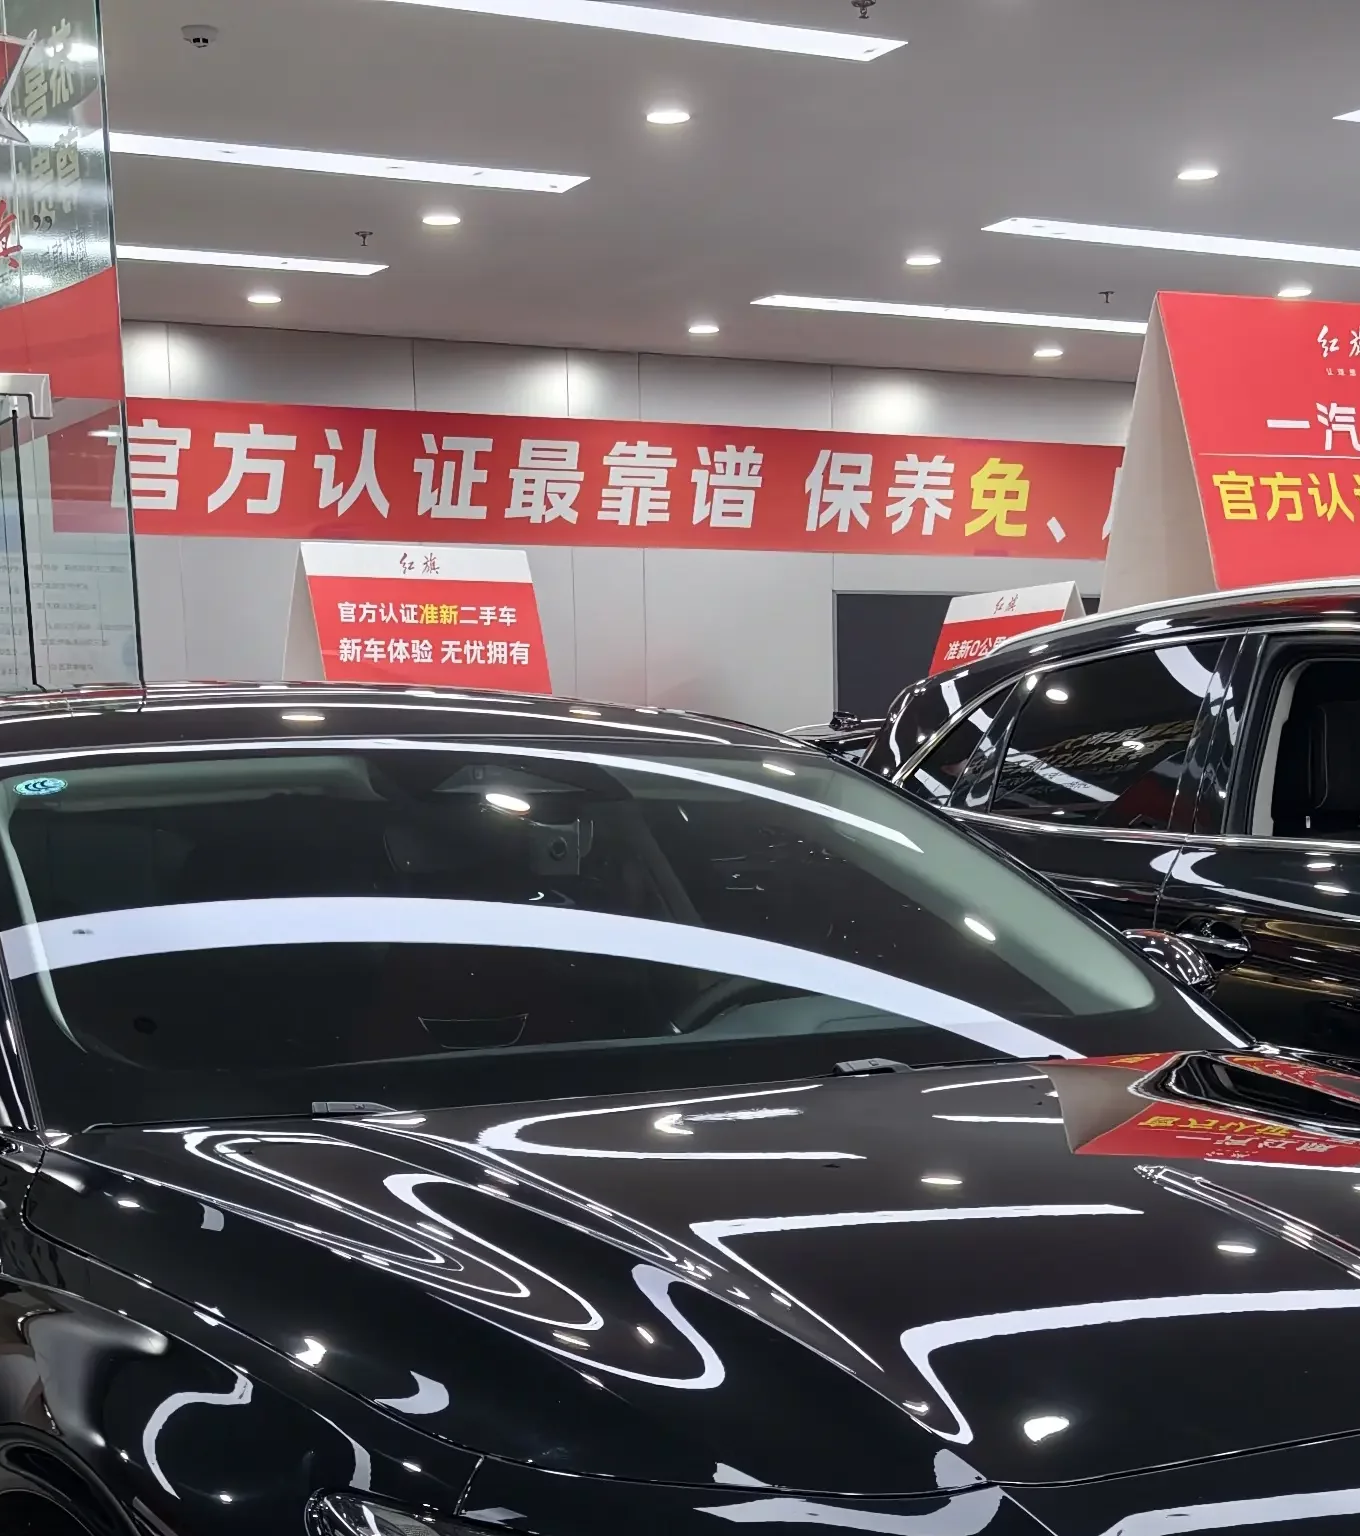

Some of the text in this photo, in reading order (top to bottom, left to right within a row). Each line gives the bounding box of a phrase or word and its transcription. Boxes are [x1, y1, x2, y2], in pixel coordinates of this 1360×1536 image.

[109, 418, 1124, 543] 官方认证最靠谱 保养免、
[398, 551, 440, 575] 红旗
[337, 602, 517, 627] 官方认证准新二手车
[338, 637, 530, 666] 新车体验 无忧拥有
